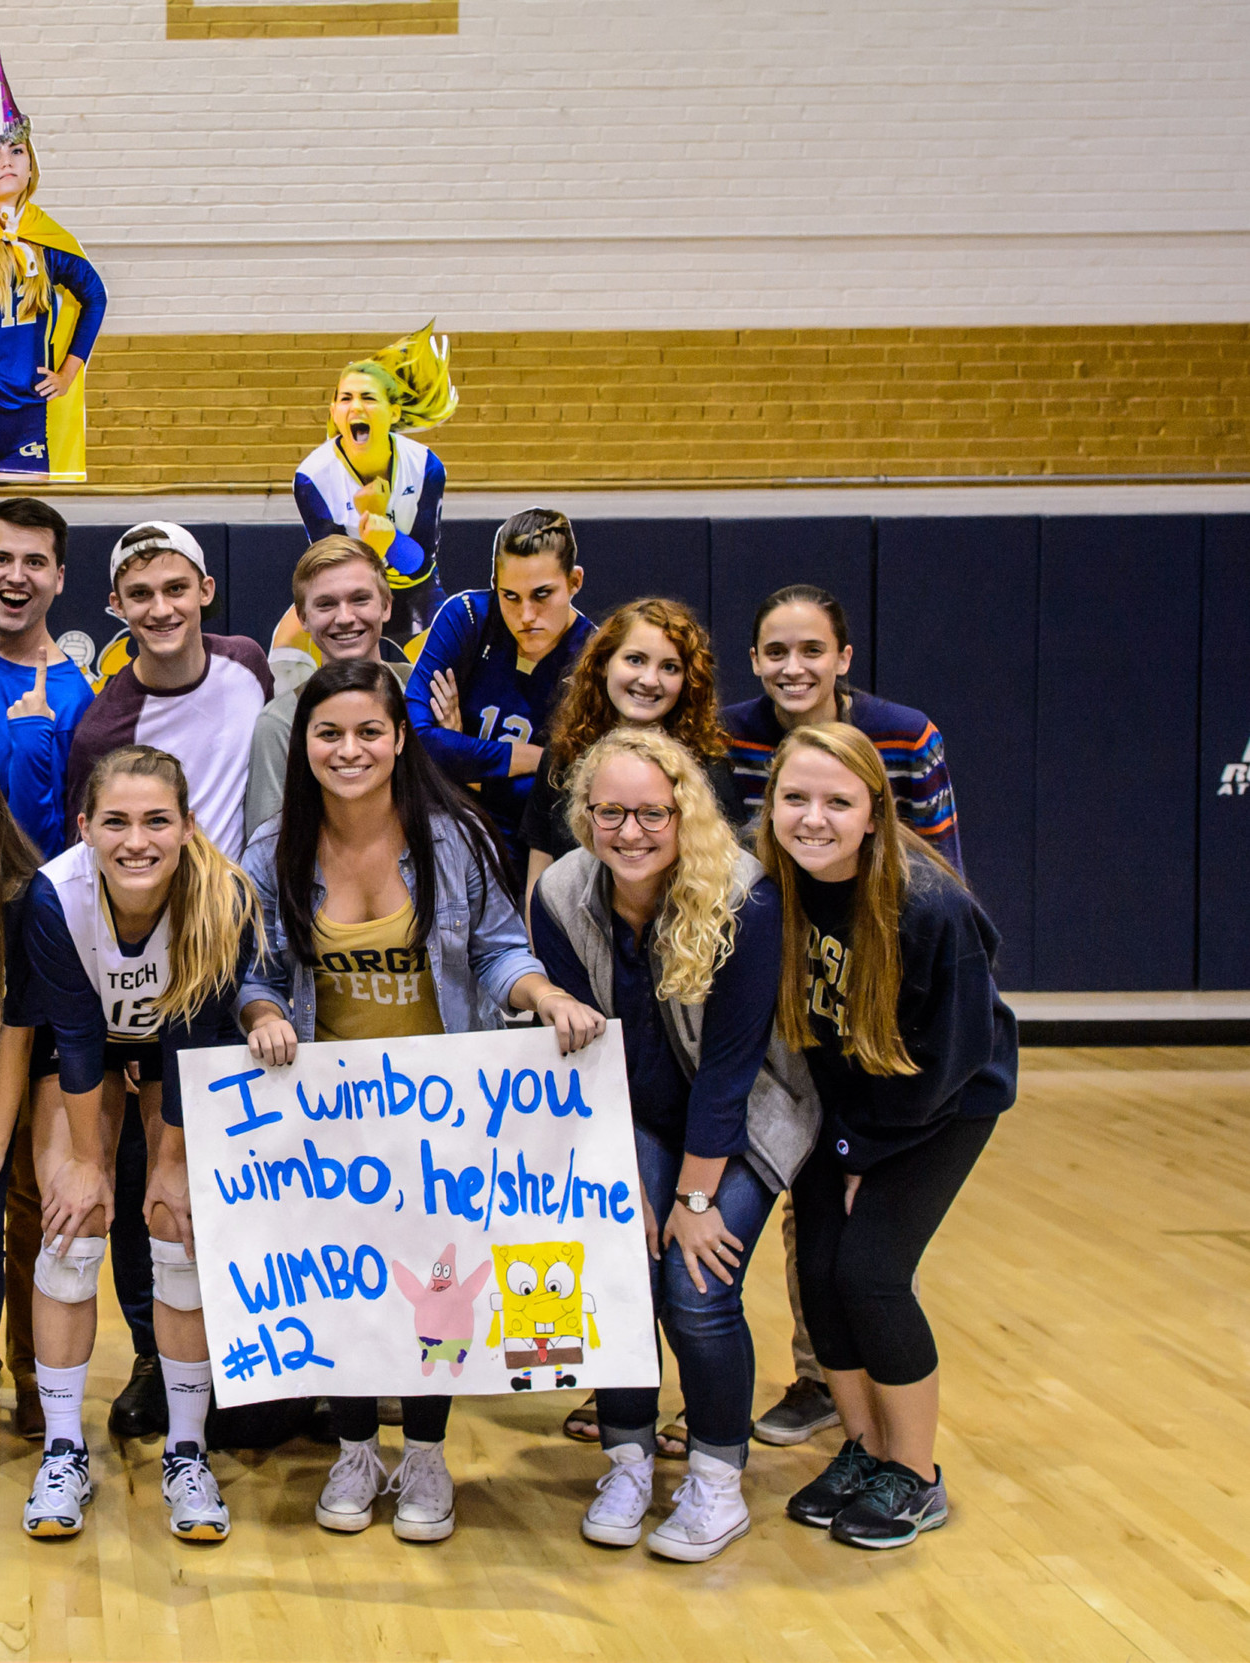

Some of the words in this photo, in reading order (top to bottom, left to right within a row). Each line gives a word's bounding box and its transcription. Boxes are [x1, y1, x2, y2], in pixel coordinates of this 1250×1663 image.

[107, 962, 159, 990] TECH
[111, 996, 160, 1028] 12
[208, 1067, 283, 1137] I
[296, 1052, 465, 1128] wimbo,
[478, 1067, 593, 1138] you
[214, 1138, 404, 1213] wimbo,
[420, 1138, 635, 1232] he/she/me
[228, 1244, 388, 1315] WIMBO
[222, 1316, 335, 1382] #12
